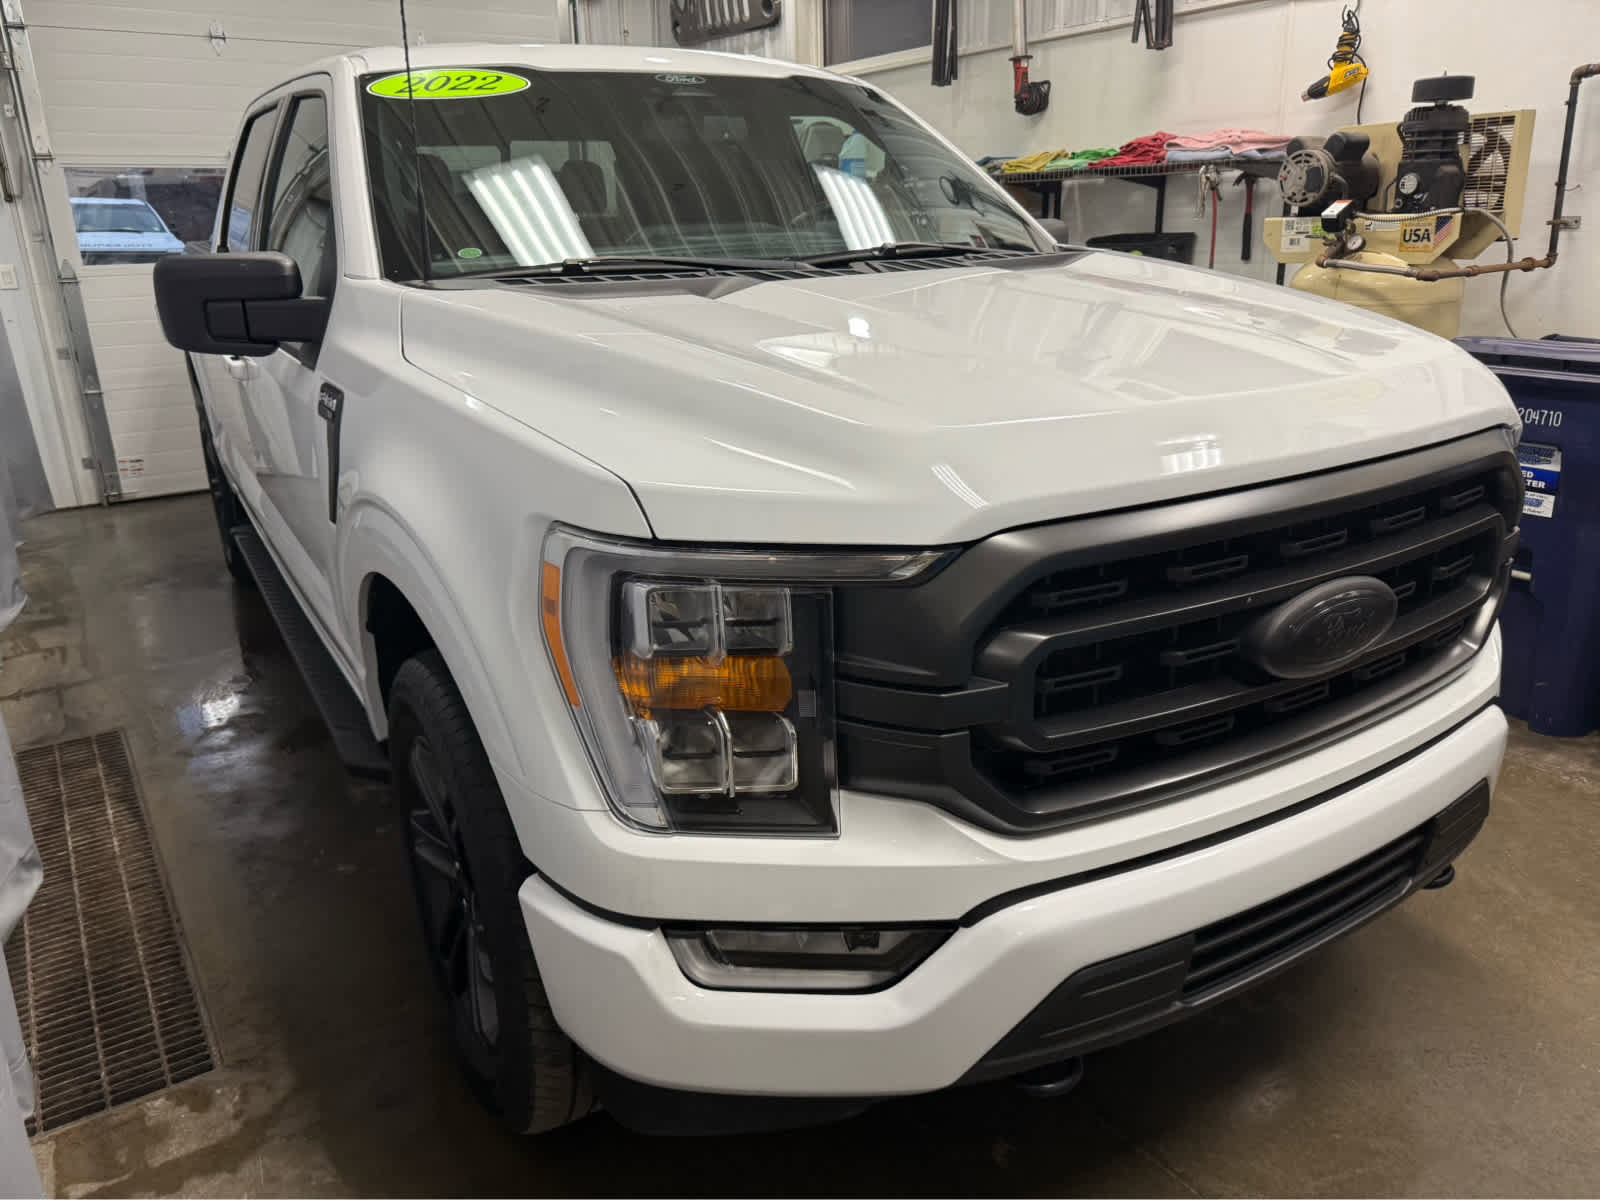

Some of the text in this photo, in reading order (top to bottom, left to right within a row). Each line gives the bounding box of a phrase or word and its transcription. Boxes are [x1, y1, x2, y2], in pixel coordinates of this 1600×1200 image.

[395, 75, 503, 94] 2022
[1403, 228, 1431, 243] USA
[1518, 407, 1562, 427] 204710
